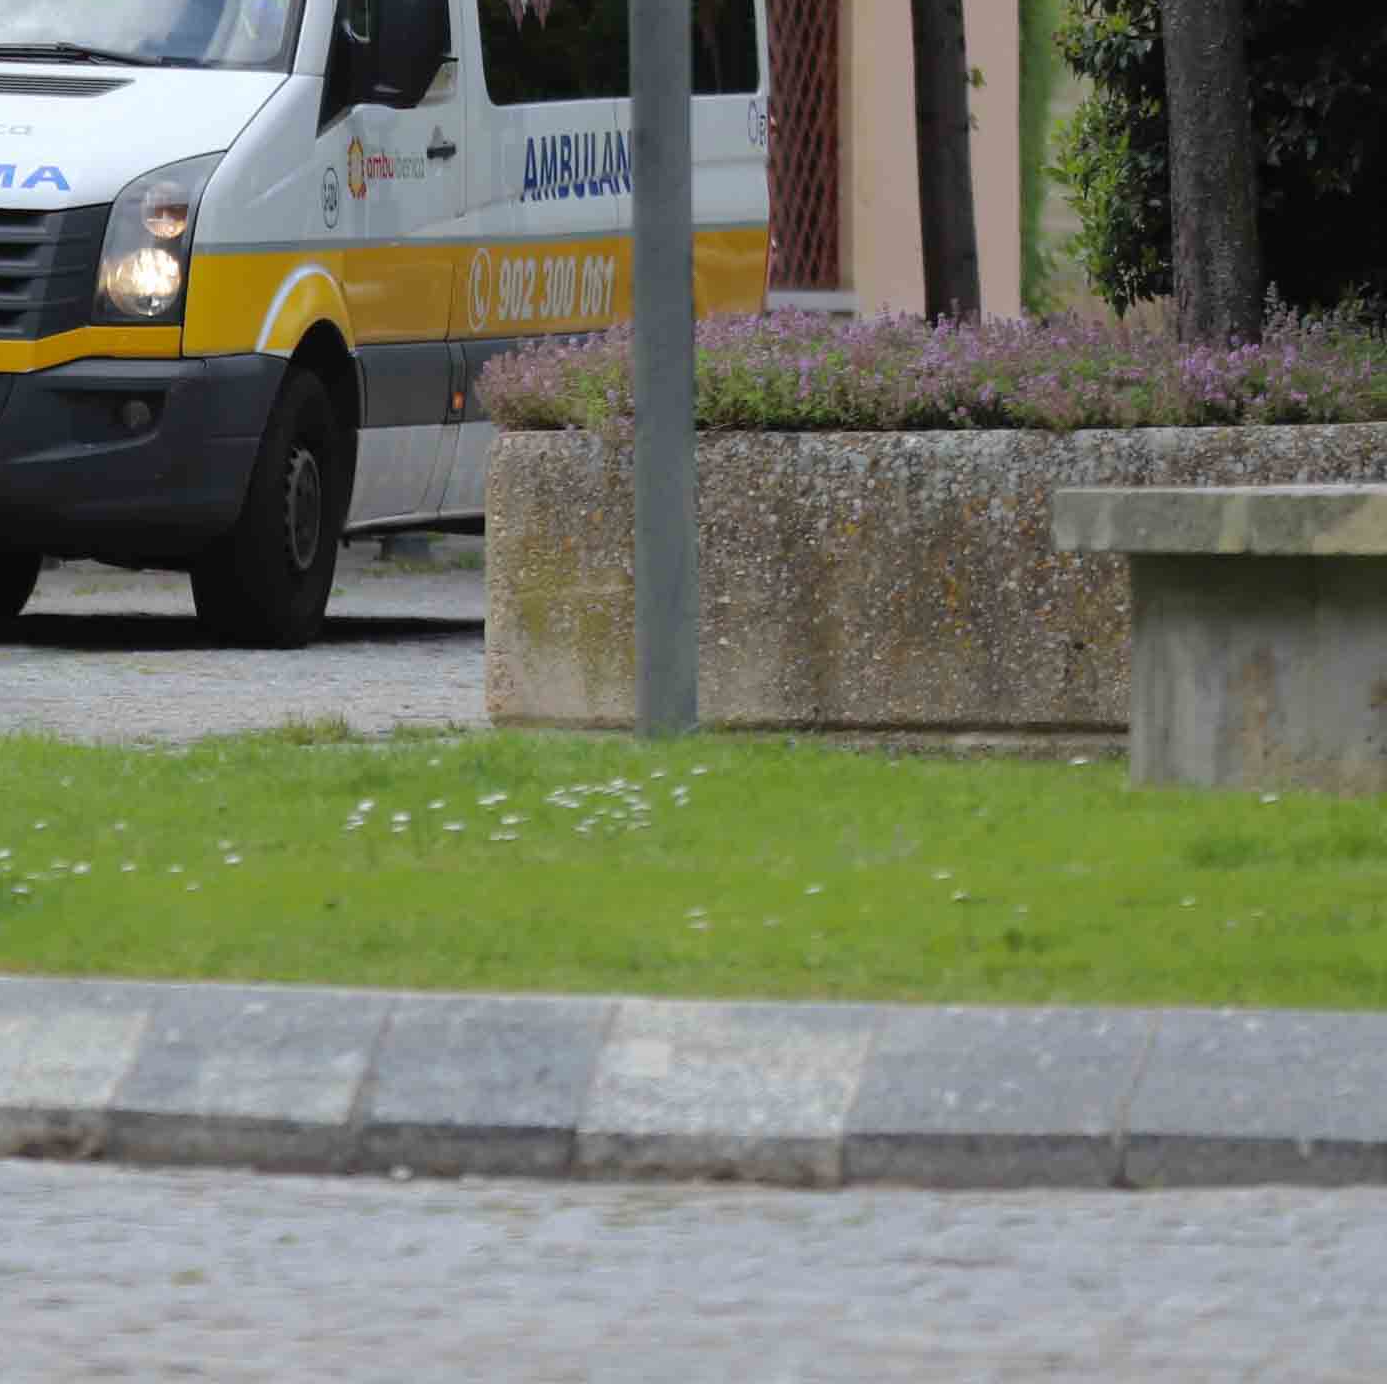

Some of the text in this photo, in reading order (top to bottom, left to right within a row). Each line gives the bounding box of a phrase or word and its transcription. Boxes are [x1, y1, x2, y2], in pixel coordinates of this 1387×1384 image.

[520, 129, 633, 202] AMBULAN
[498, 256, 536, 321] 902
[539, 256, 576, 319] 300
